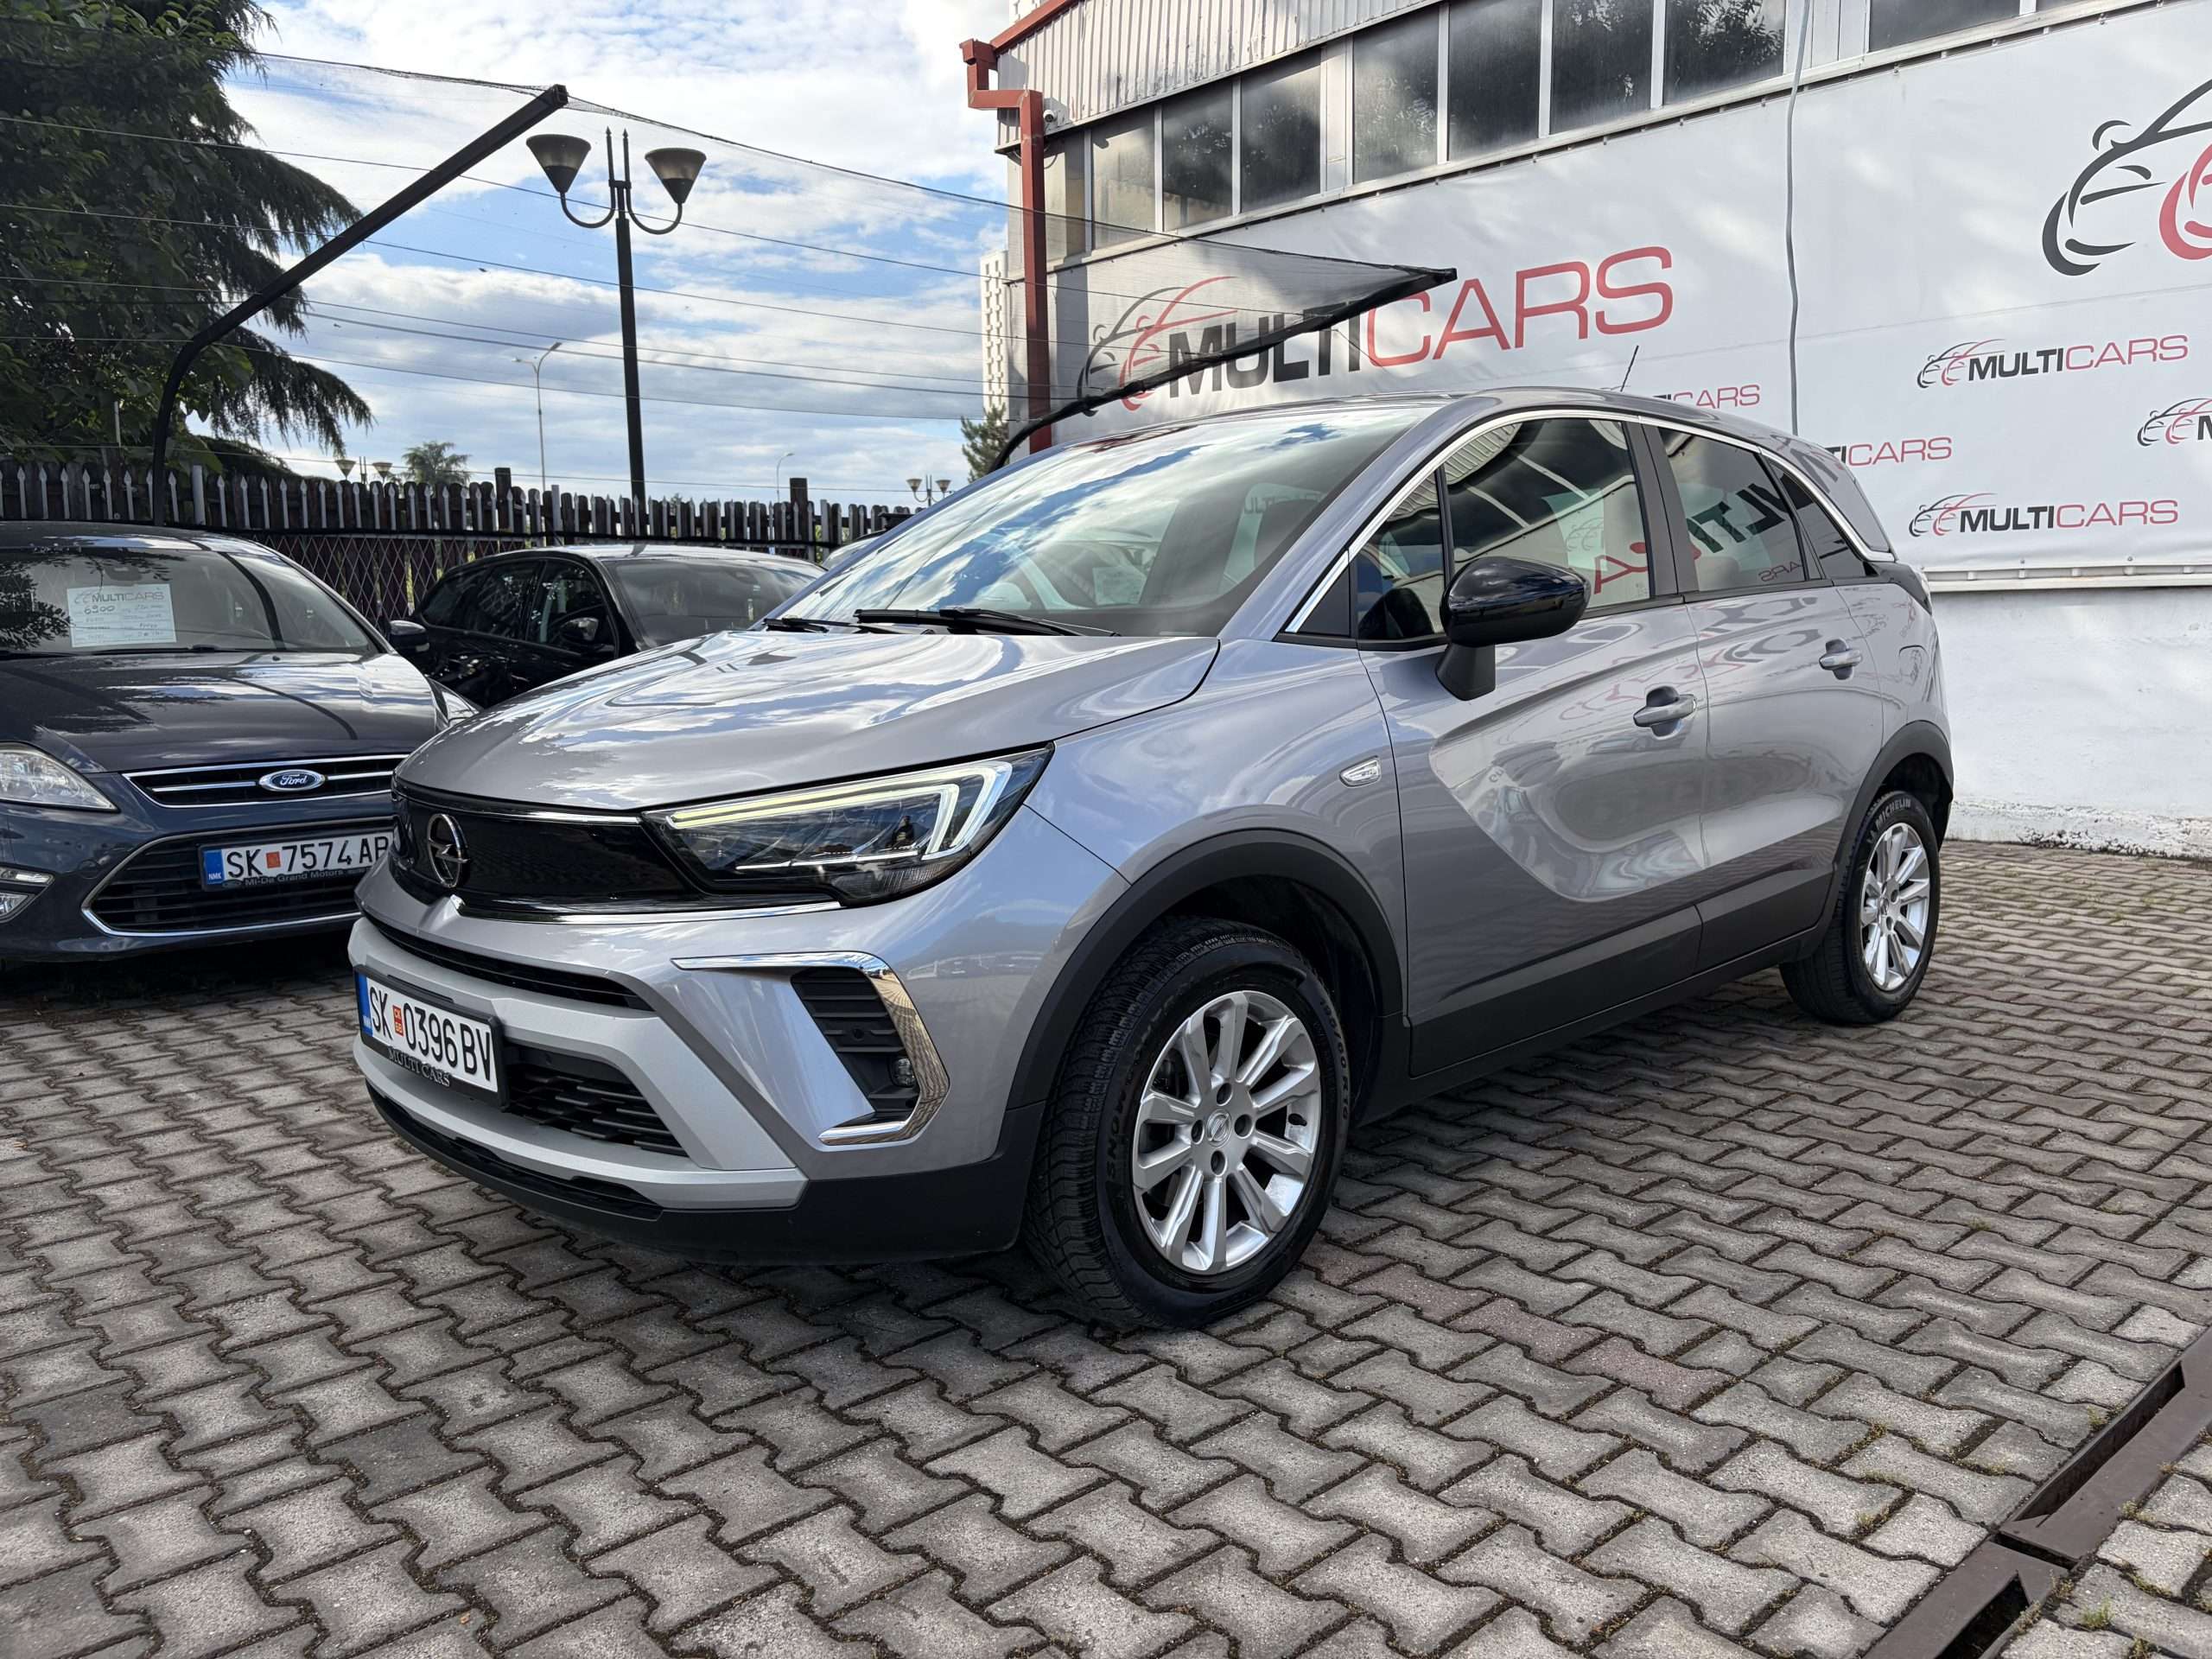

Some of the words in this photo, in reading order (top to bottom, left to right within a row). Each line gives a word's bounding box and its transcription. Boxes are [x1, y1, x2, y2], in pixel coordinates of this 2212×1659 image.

[1169, 246, 1673, 398] MULTICARS
[1969, 335, 2189, 381] MULTICARS
[1960, 499, 2178, 533] MULTICARS
[92, 591, 164, 603] MULTICARS
[279, 773, 308, 785] Ford
[226, 849, 264, 879] SK
[282, 840, 353, 872] 7574
[309, 869, 344, 879] Motors
[370, 986, 393, 1041] SK
[403, 1002, 458, 1068] 0396
[460, 1022, 491, 1082] BV
